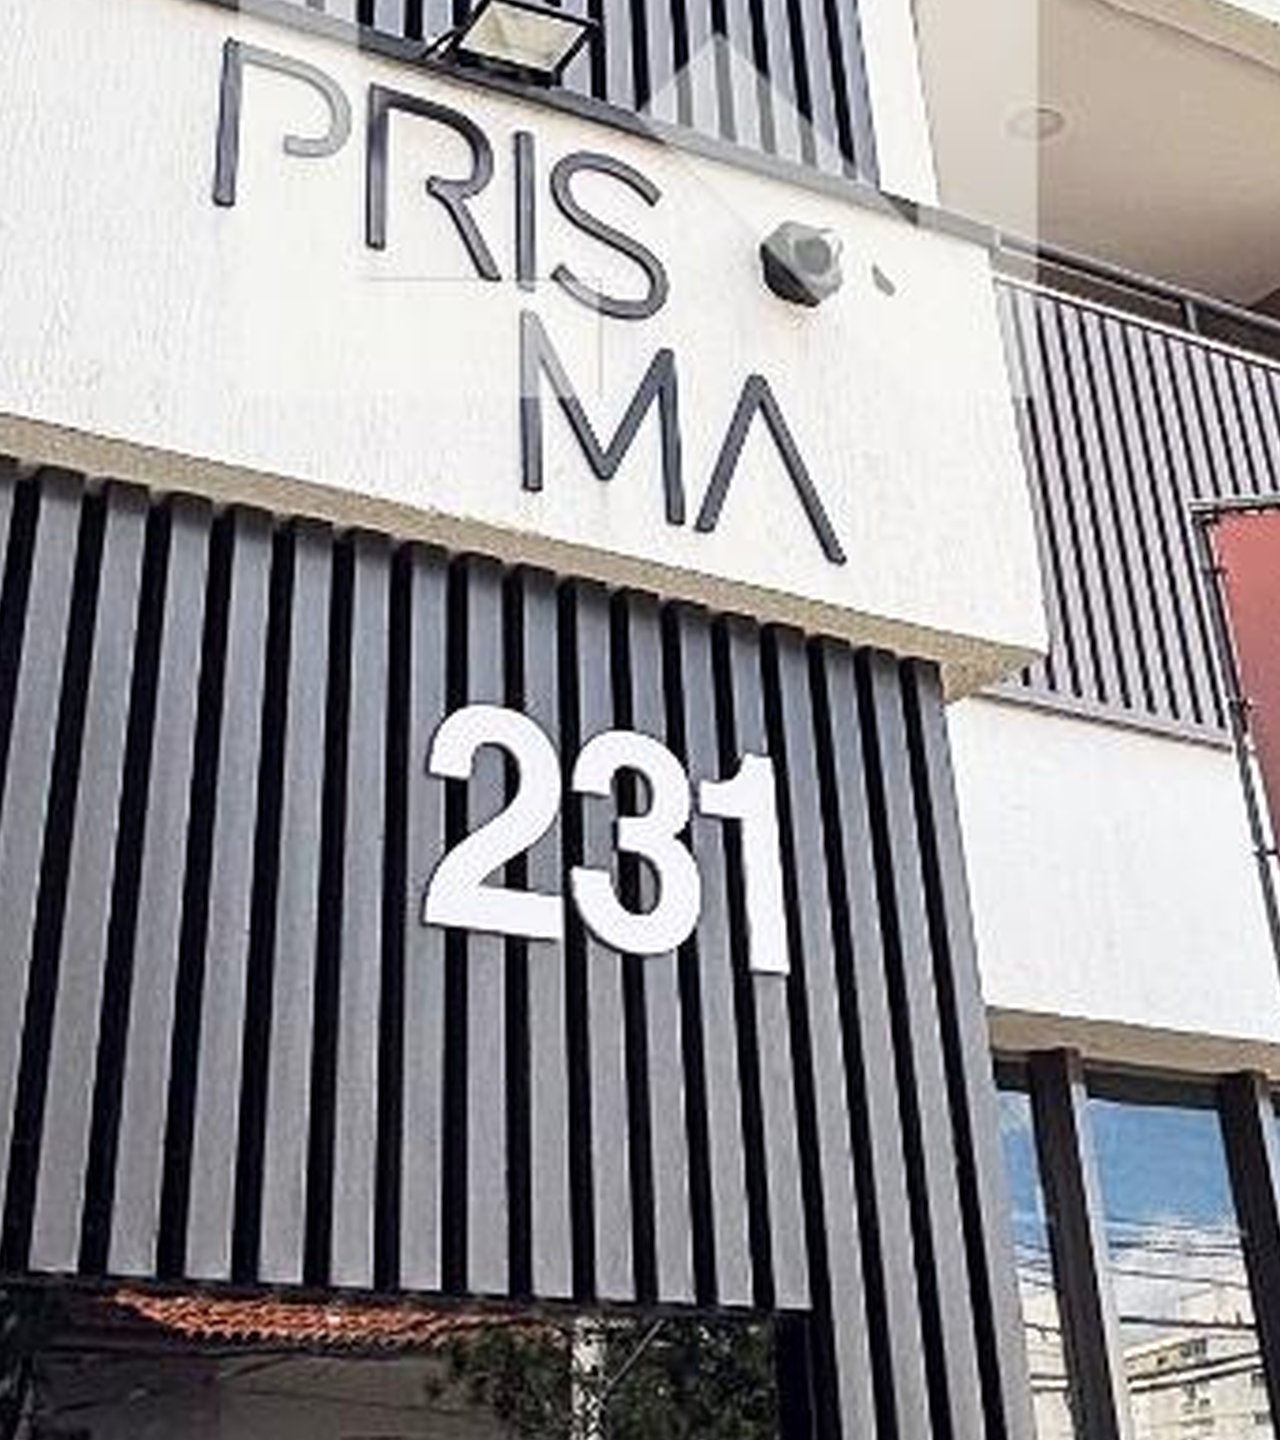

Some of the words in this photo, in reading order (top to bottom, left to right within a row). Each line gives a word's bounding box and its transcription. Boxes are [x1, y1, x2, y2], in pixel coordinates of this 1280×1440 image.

[212, 37, 671, 321] PRIS
[519, 309, 848, 566] MA
[424, 704, 791, 975] 231
